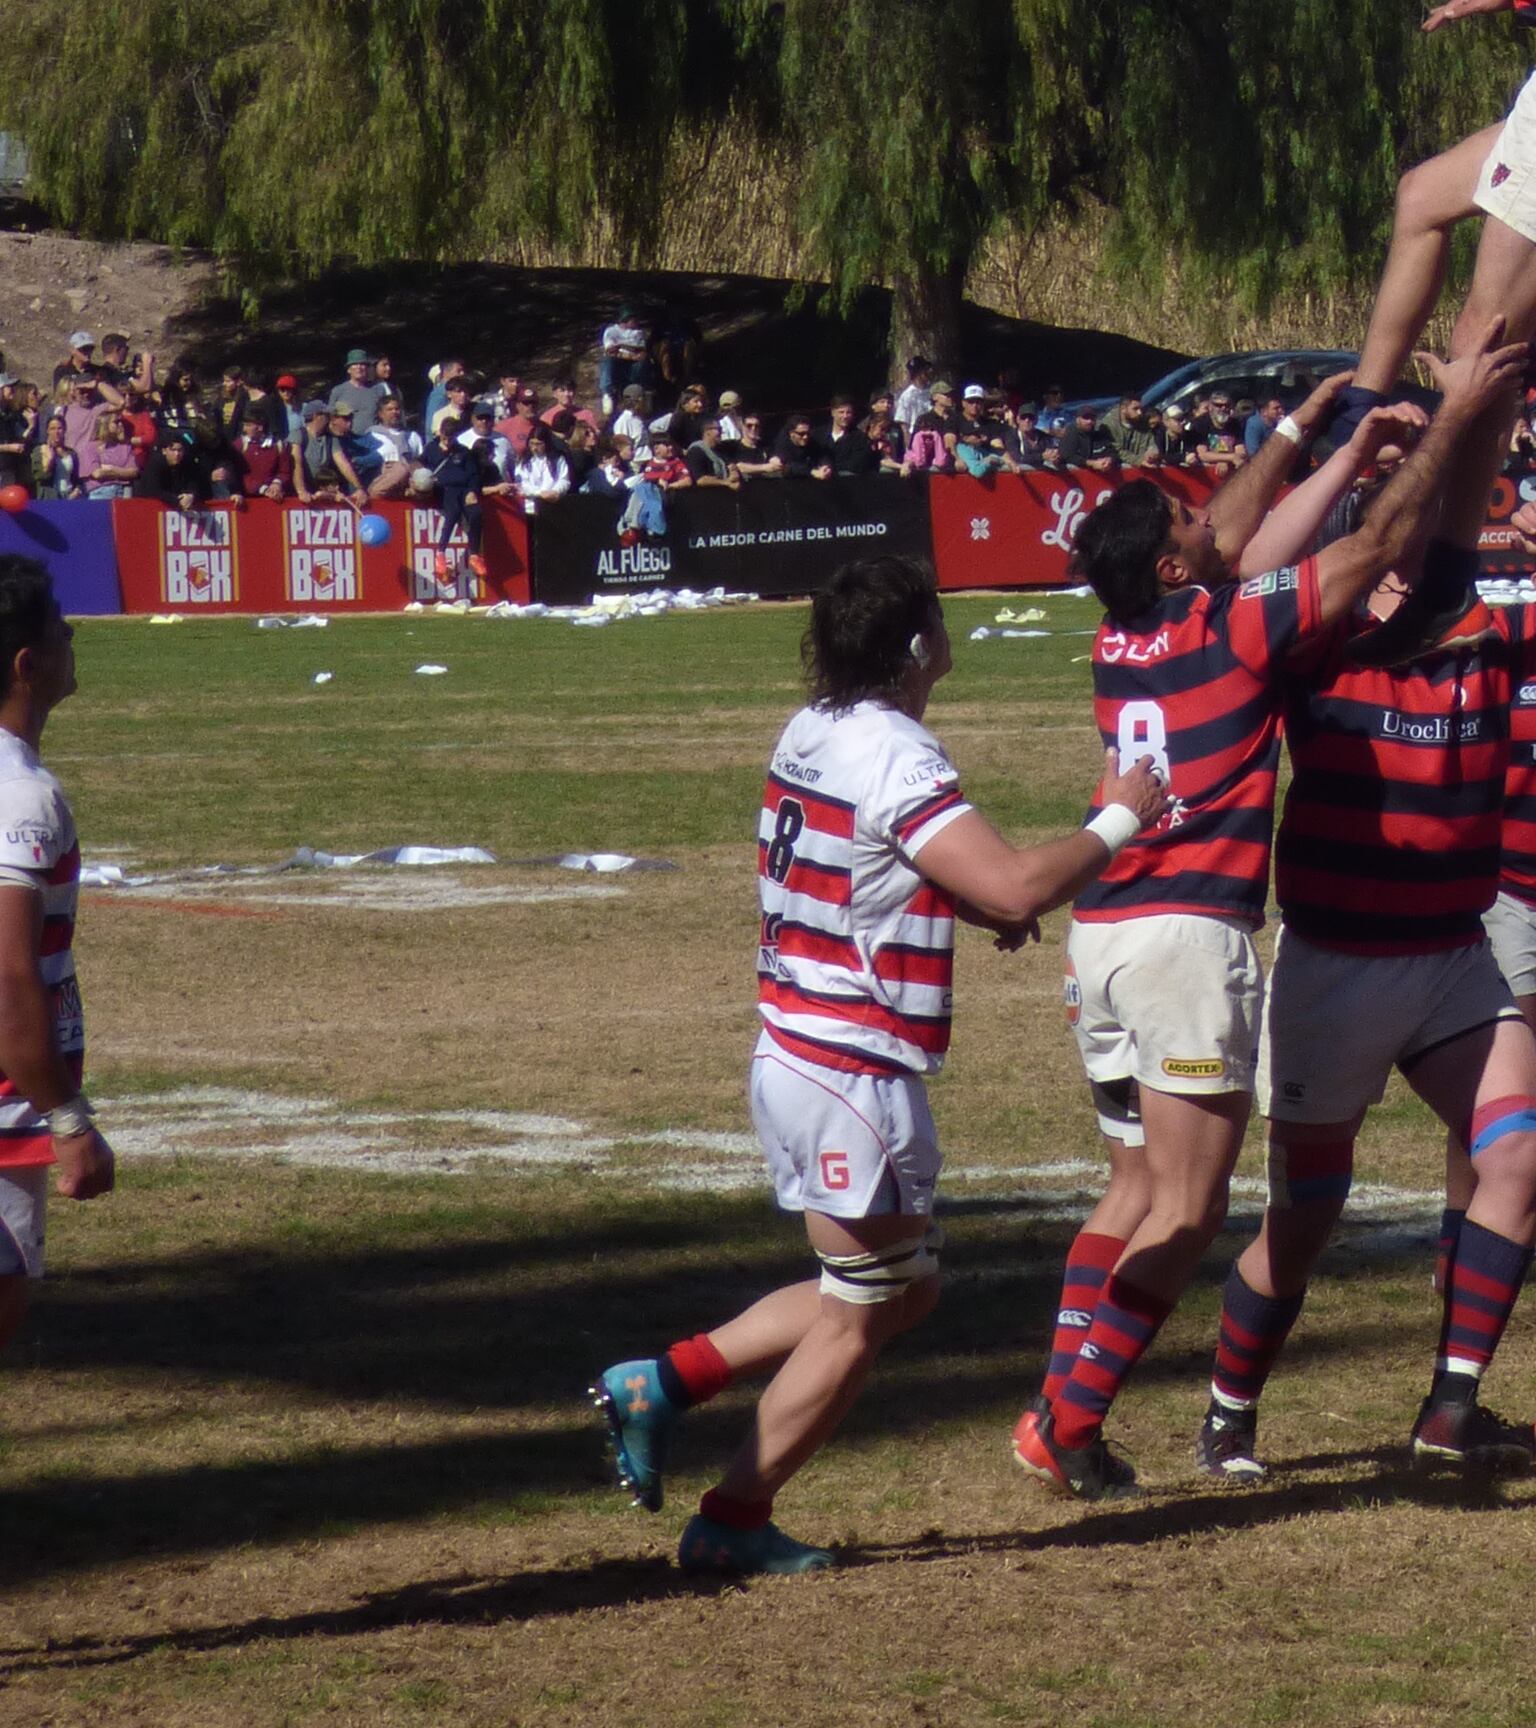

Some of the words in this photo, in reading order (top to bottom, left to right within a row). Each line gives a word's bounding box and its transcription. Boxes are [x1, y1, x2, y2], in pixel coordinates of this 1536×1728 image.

[165, 511, 229, 546] PIZZA
[290, 509, 353, 545] PIZZA
[689, 536, 706, 549] LA
[709, 532, 756, 548] MEJOR
[759, 529, 804, 544] CARNE
[806, 526, 833, 540] DEL
[836, 523, 887, 538] MUNDO
[168, 550, 231, 602] BOX
[291, 549, 355, 600] BOX
[597, 550, 619, 576] AL
[621, 542, 671, 574] FUEGO
[1383, 711, 1478, 739] Uroclíca
[1118, 700, 1171, 789] 8
[904, 762, 947, 787] ULTR
[767, 795, 806, 887] 8
[820, 1152, 850, 1191] G
